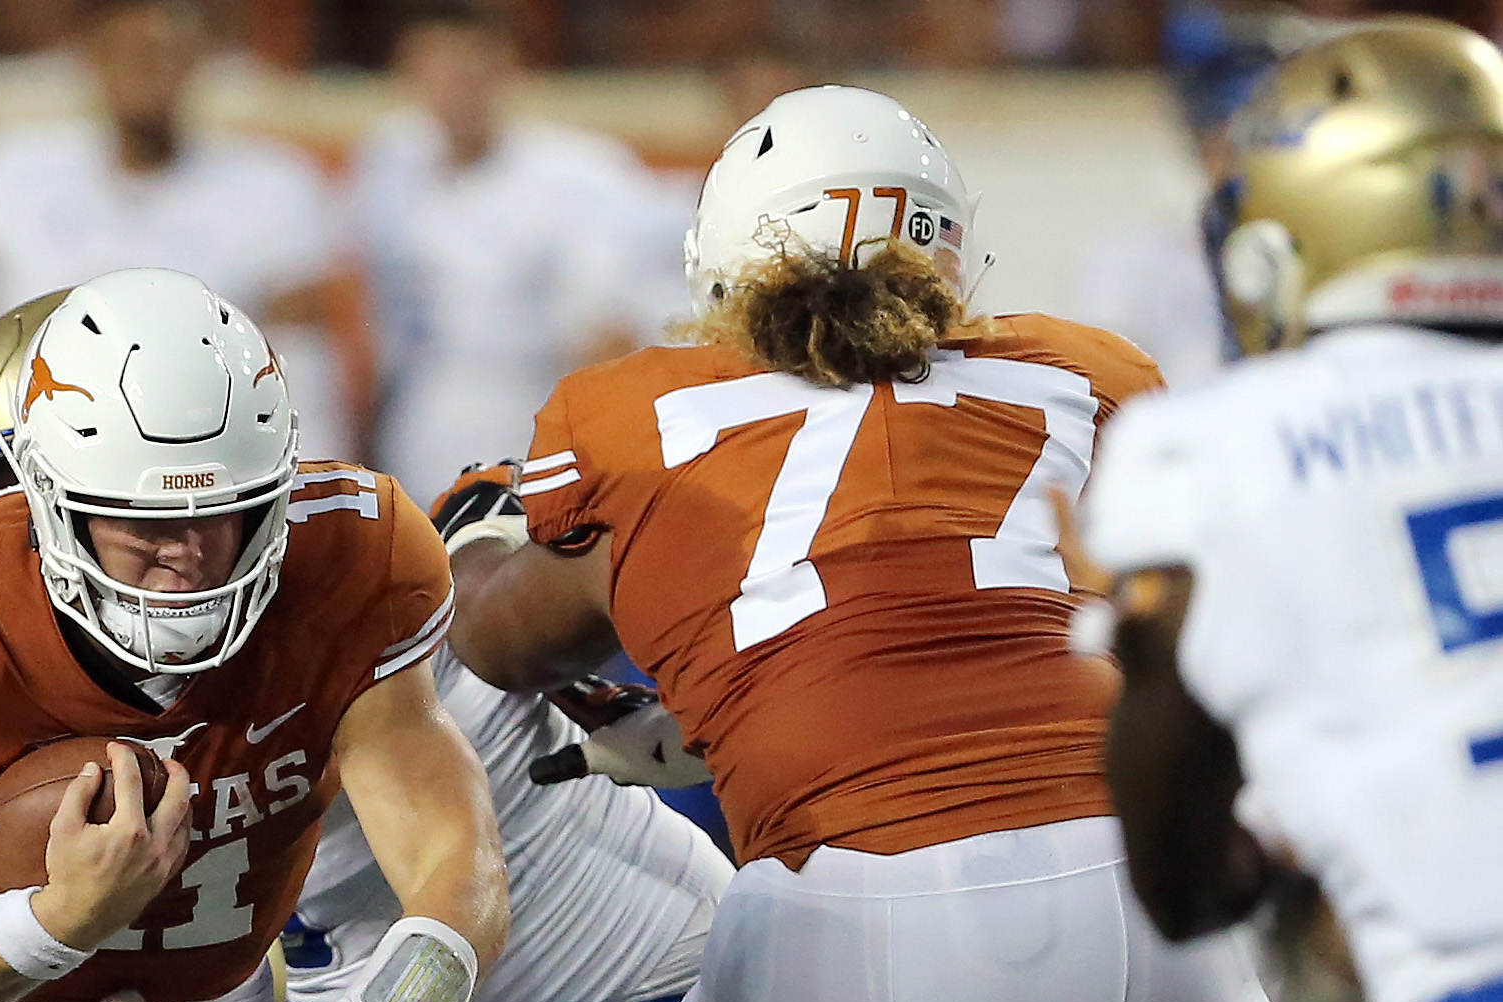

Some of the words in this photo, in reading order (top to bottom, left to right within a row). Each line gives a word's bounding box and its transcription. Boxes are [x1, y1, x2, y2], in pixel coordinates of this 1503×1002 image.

[823, 187, 907, 268] 77
[910, 213, 935, 244] FD
[162, 472, 215, 490] HORNS
[286, 470, 379, 524] 11
[654, 350, 1099, 653] 77
